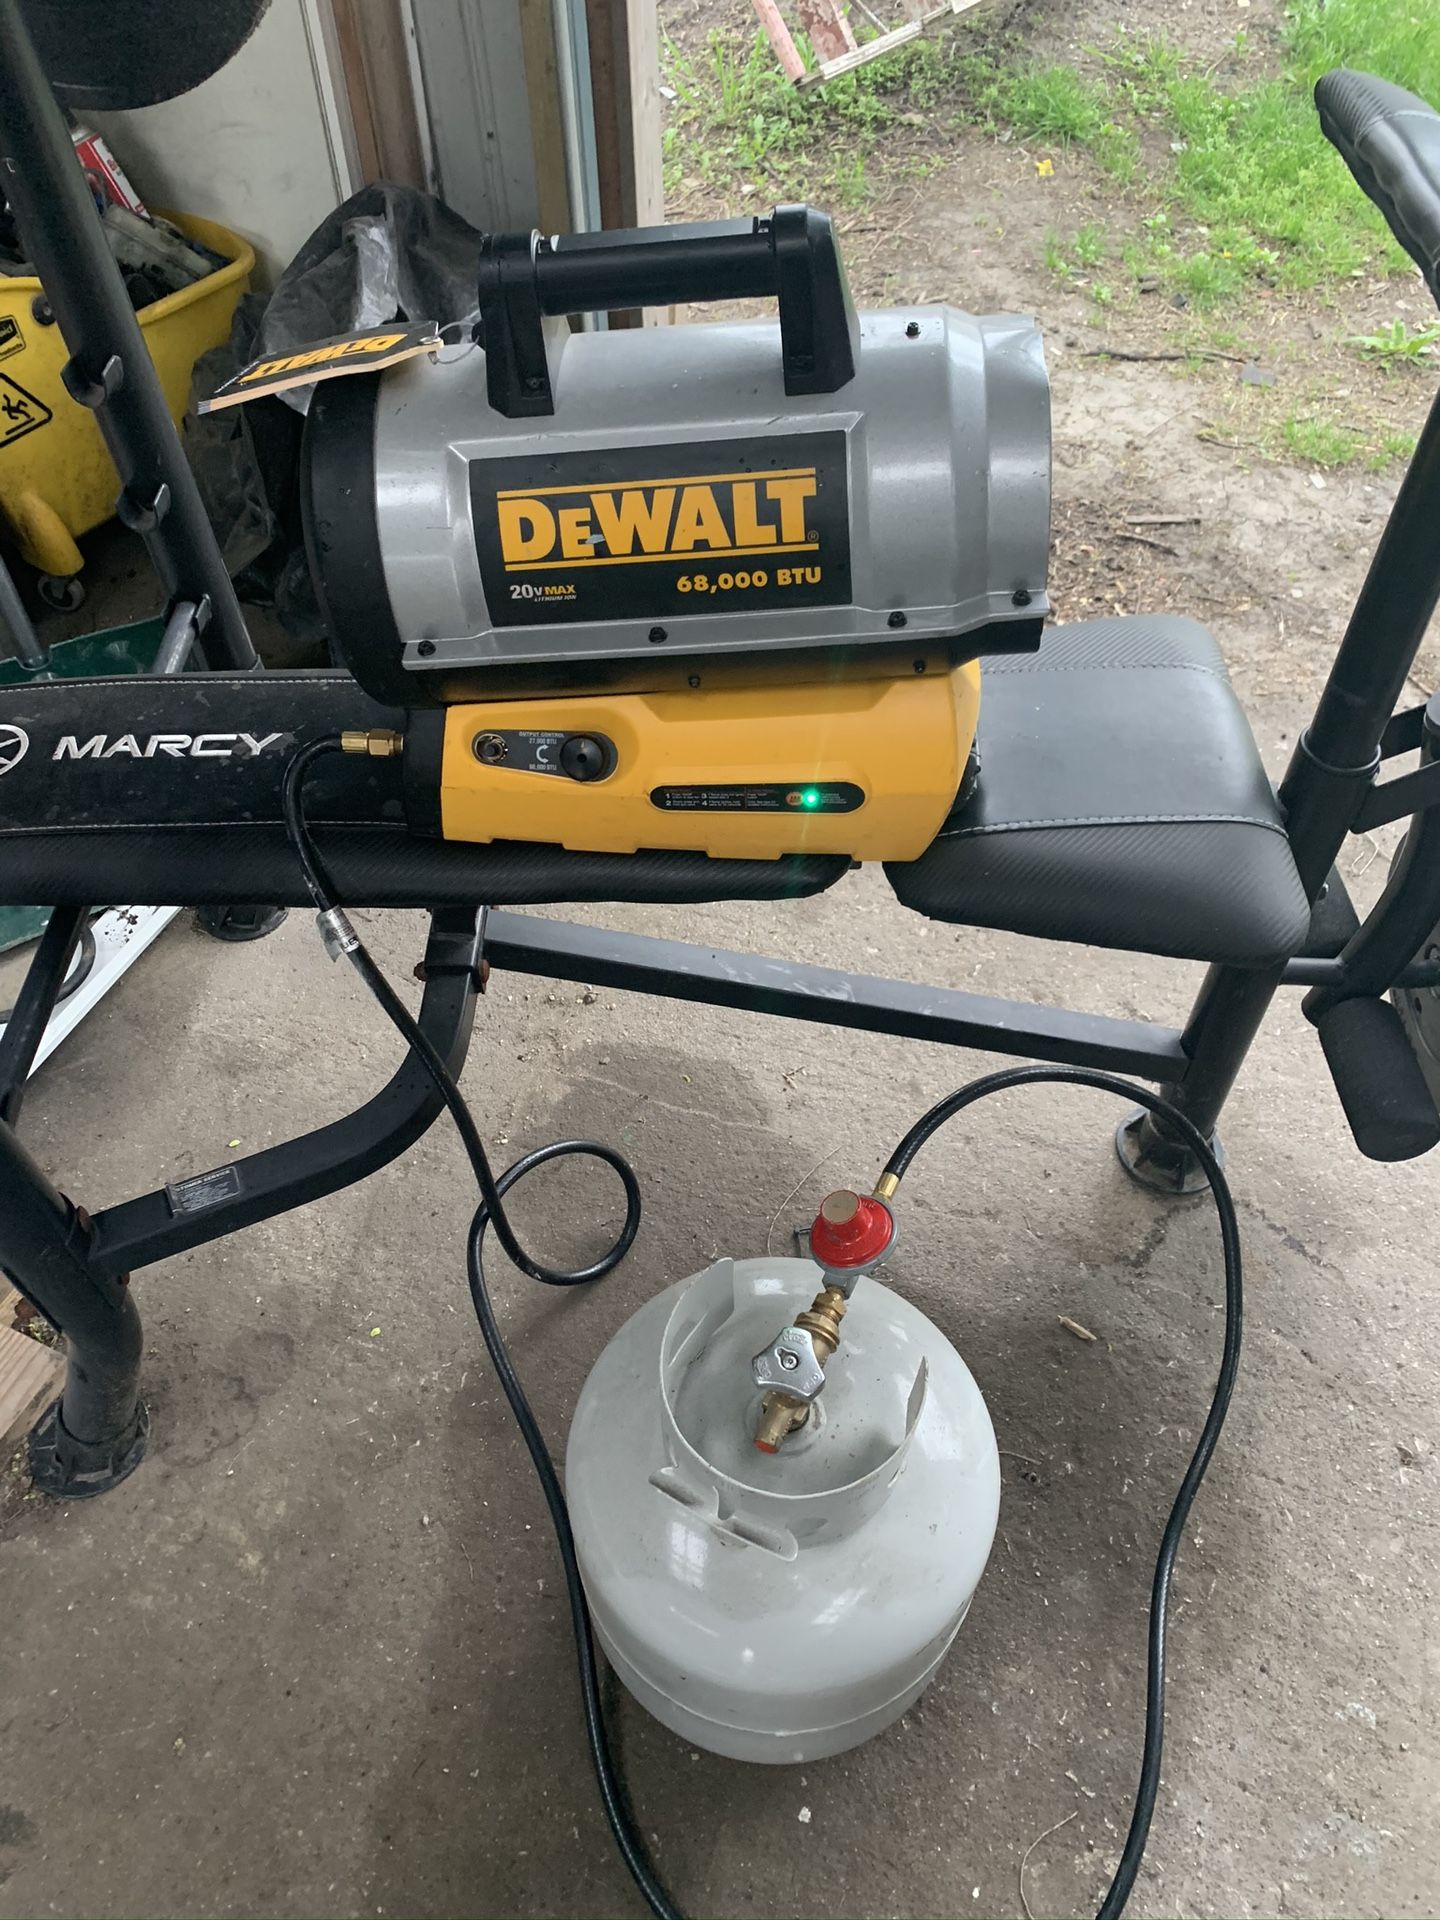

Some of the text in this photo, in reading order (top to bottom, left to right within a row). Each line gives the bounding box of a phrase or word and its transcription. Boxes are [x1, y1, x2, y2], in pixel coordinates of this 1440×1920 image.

[497, 477, 817, 563] DEWALT
[543, 584, 577, 596] MAX
[676, 566, 822, 594] 68,000 BTU
[52, 733, 284, 760] MARCY
